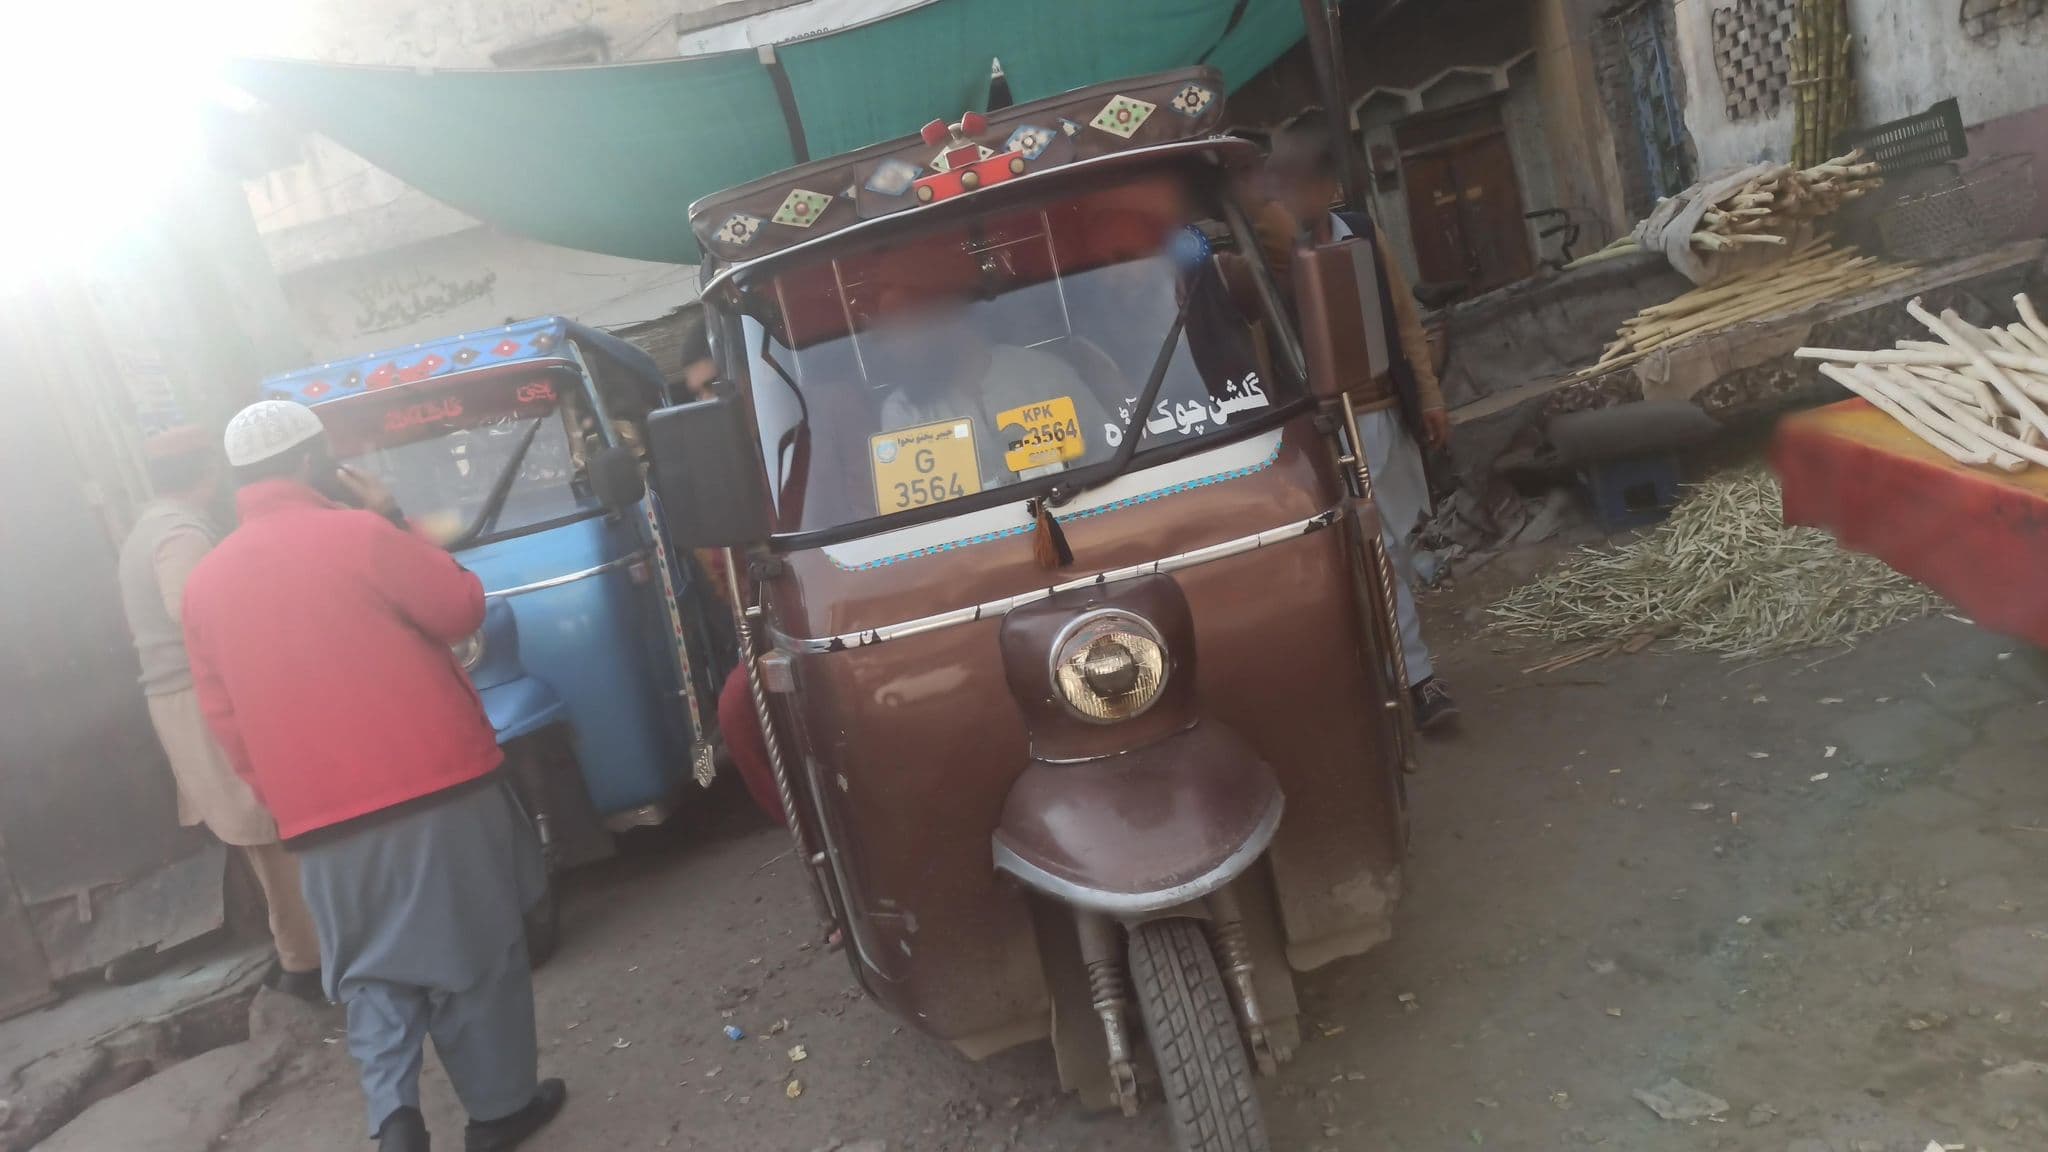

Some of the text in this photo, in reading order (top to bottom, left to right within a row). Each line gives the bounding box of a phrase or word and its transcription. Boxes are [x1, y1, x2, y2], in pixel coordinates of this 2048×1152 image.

[1023, 404, 1053, 423] KPK
[1209, 371, 1269, 425] گلشن
[1146, 399, 1207, 435] چوک
[915, 449, 936, 474] G
[894, 472, 965, 508] 3564
